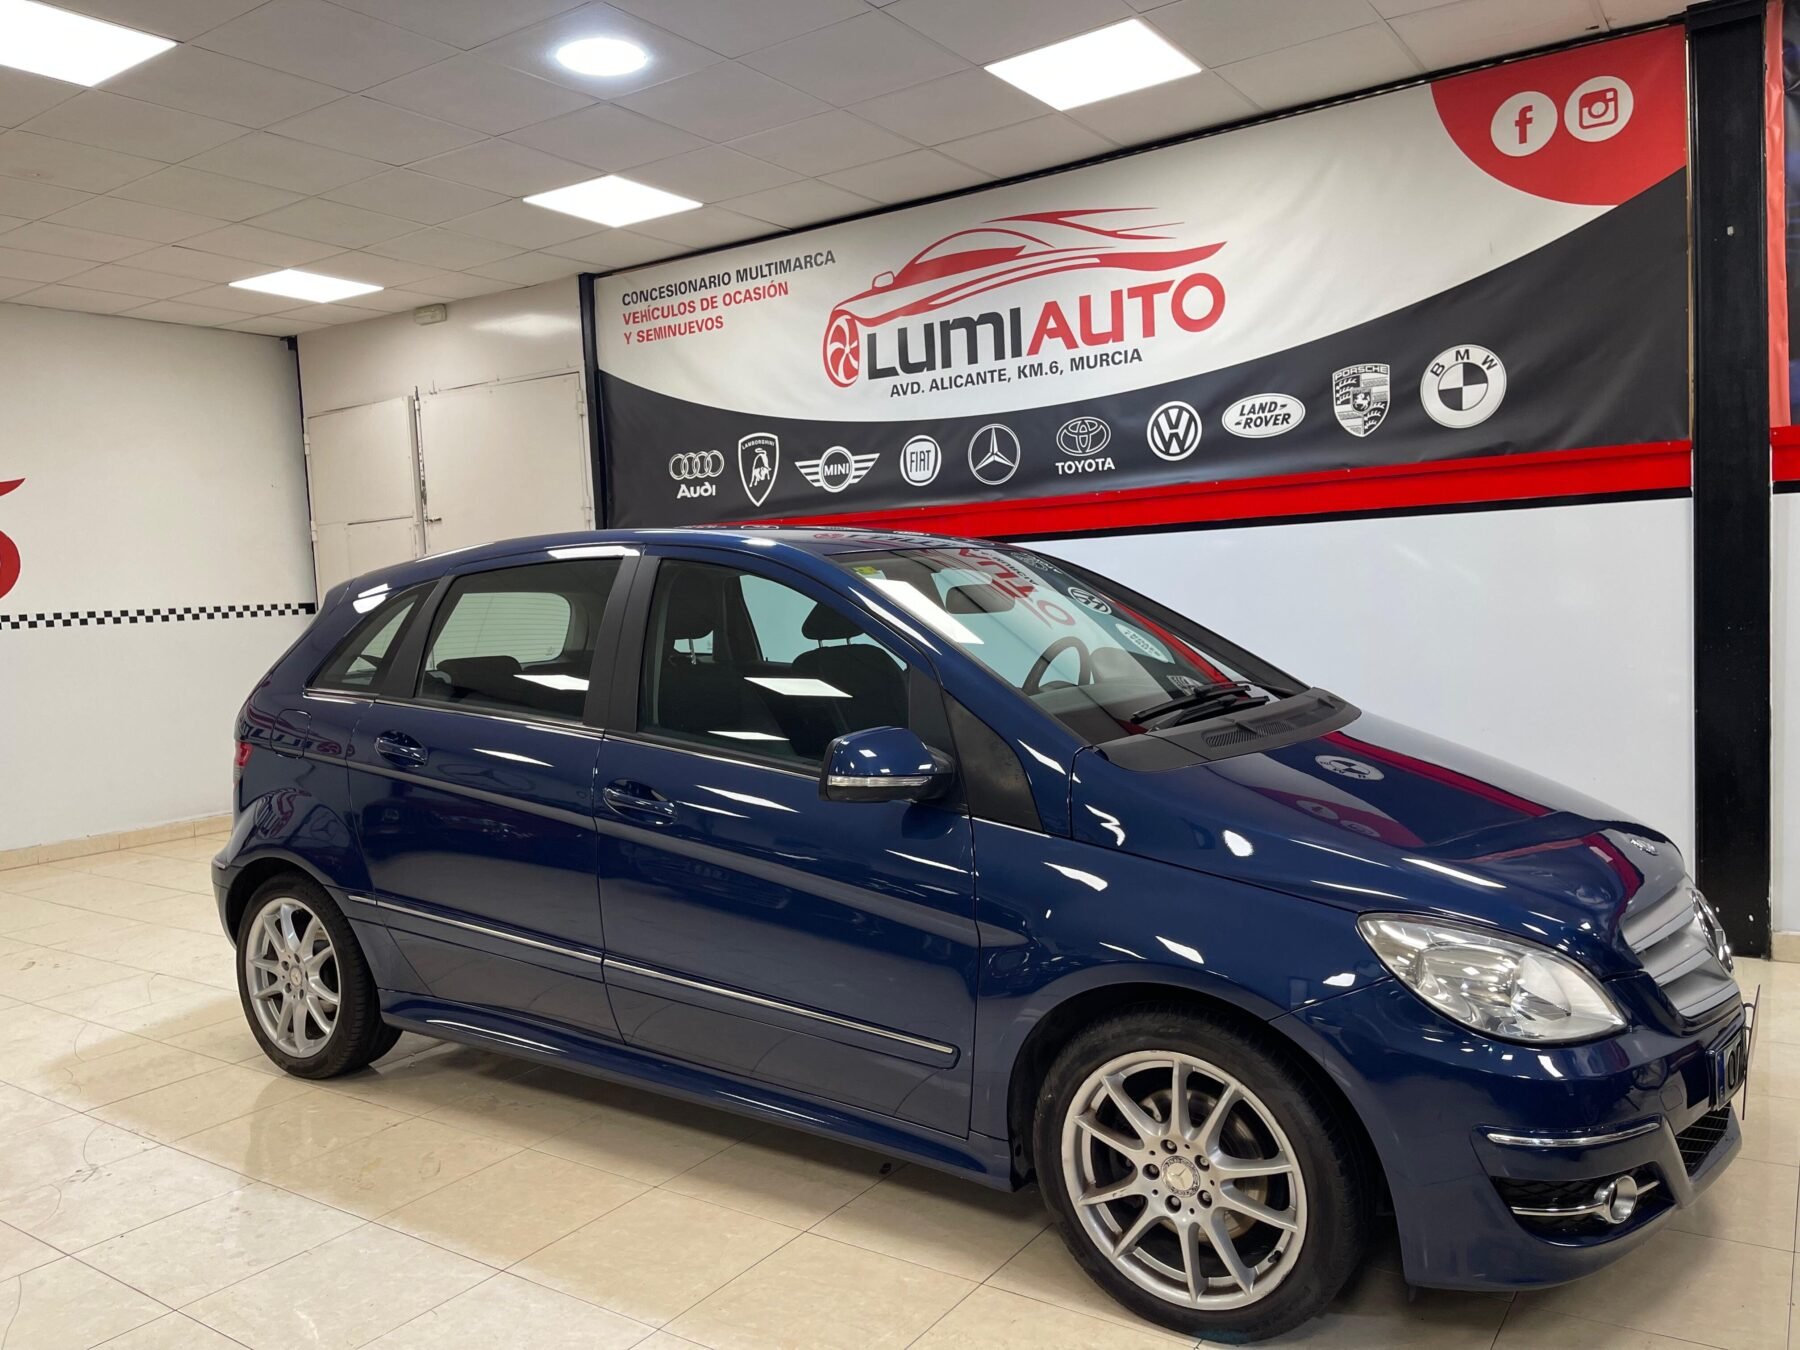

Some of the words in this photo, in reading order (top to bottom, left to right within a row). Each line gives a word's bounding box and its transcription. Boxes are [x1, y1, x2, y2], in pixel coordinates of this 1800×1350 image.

[622, 271, 732, 306] CONCESIONARIO
[735, 250, 836, 284] MULTIMARCA
[622, 299, 697, 326] VEHÍCULOS
[700, 295, 719, 312] DE
[722, 279, 789, 308] OCASIÓN
[624, 332, 633, 345] Y
[636, 315, 724, 344] SEMINUEVOS
[890, 381, 926, 398] AVD.
[928, 368, 1012, 393] ALICANTE,
[1016, 359, 1065, 380] KM.6,
[1069, 347, 1143, 372] MURCIA
[1334, 365, 1389, 381] PORSCHE
[1429, 348, 1498, 378] BMW
[1242, 413, 1291, 430] ROVER
[741, 439, 775, 450] LAMBORGHINI
[823, 462, 850, 477] MINI
[909, 449, 932, 473] FIAT
[1055, 457, 1116, 475] TOYOTA
[676, 481, 716, 499] Audi
